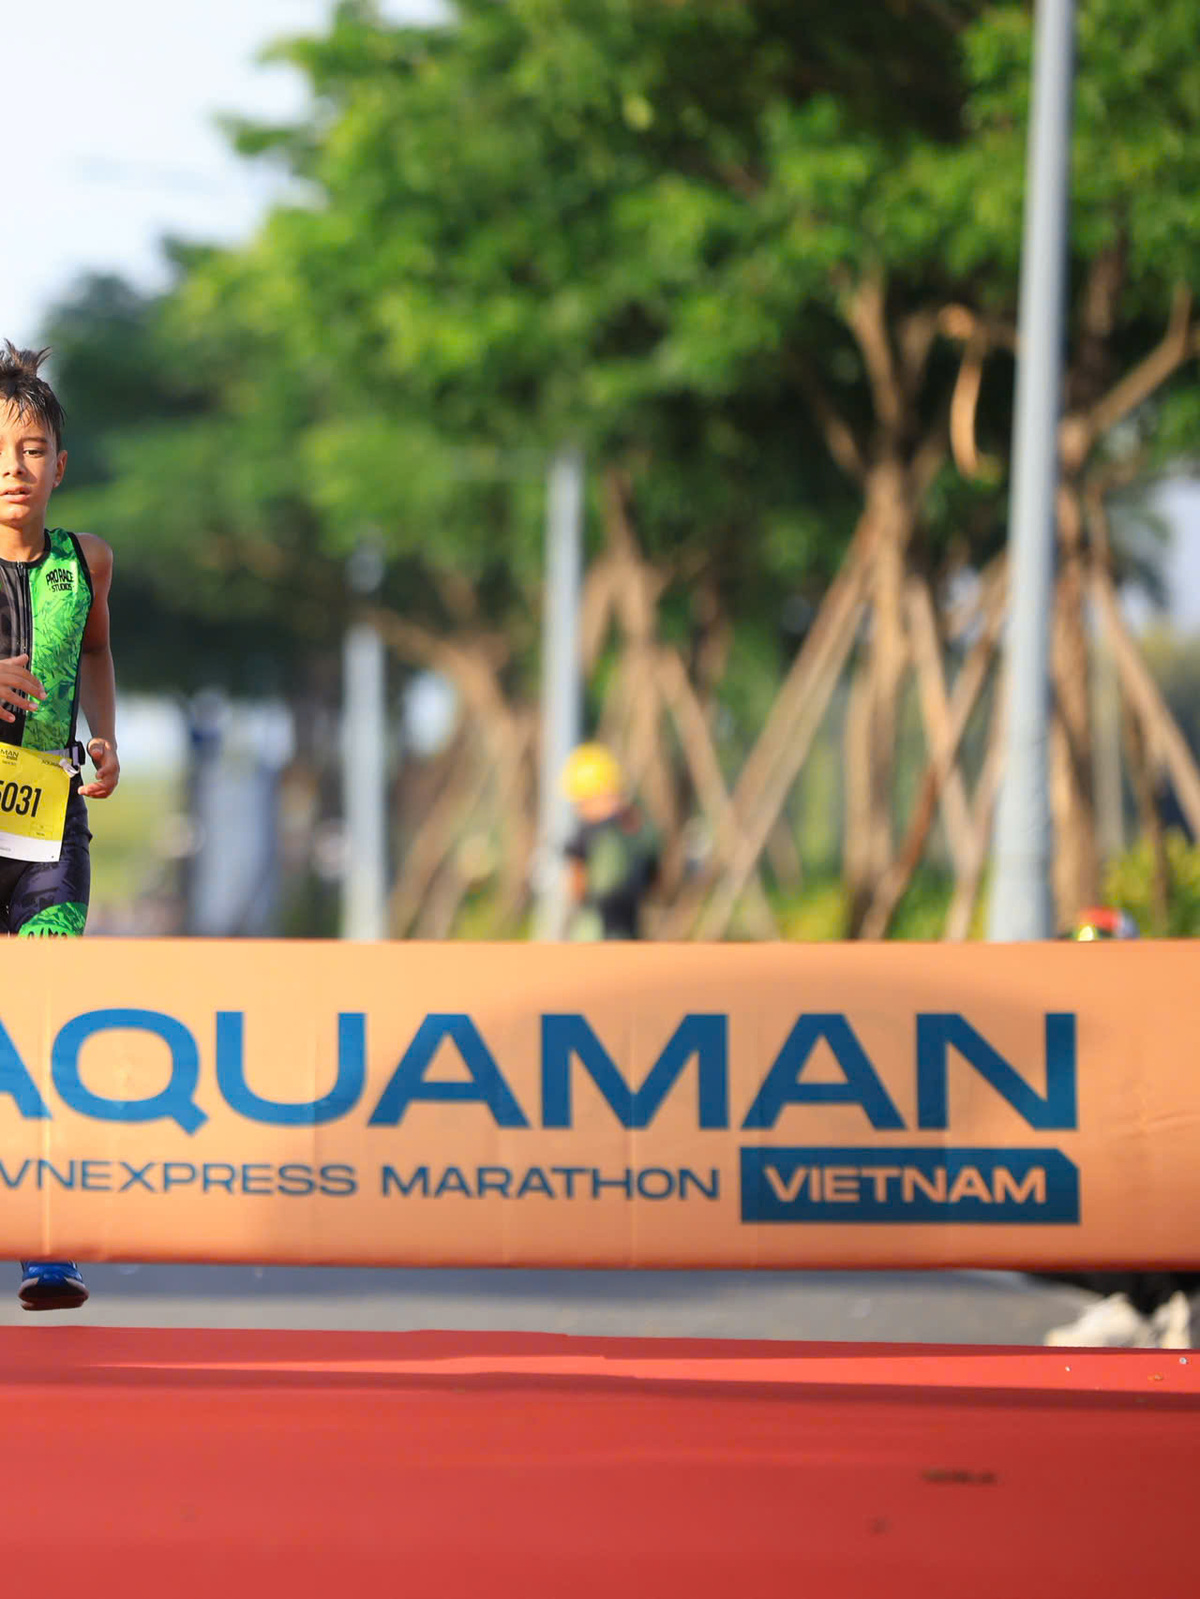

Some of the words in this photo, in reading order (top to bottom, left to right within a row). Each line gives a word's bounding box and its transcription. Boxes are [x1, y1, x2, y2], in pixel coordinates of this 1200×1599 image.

[46, 569, 58, 586] PRO
[58, 568, 73, 582] RACE
[380, 1164, 721, 1201] MARATHON
[764, 1165, 1048, 1205] VIETNAM
